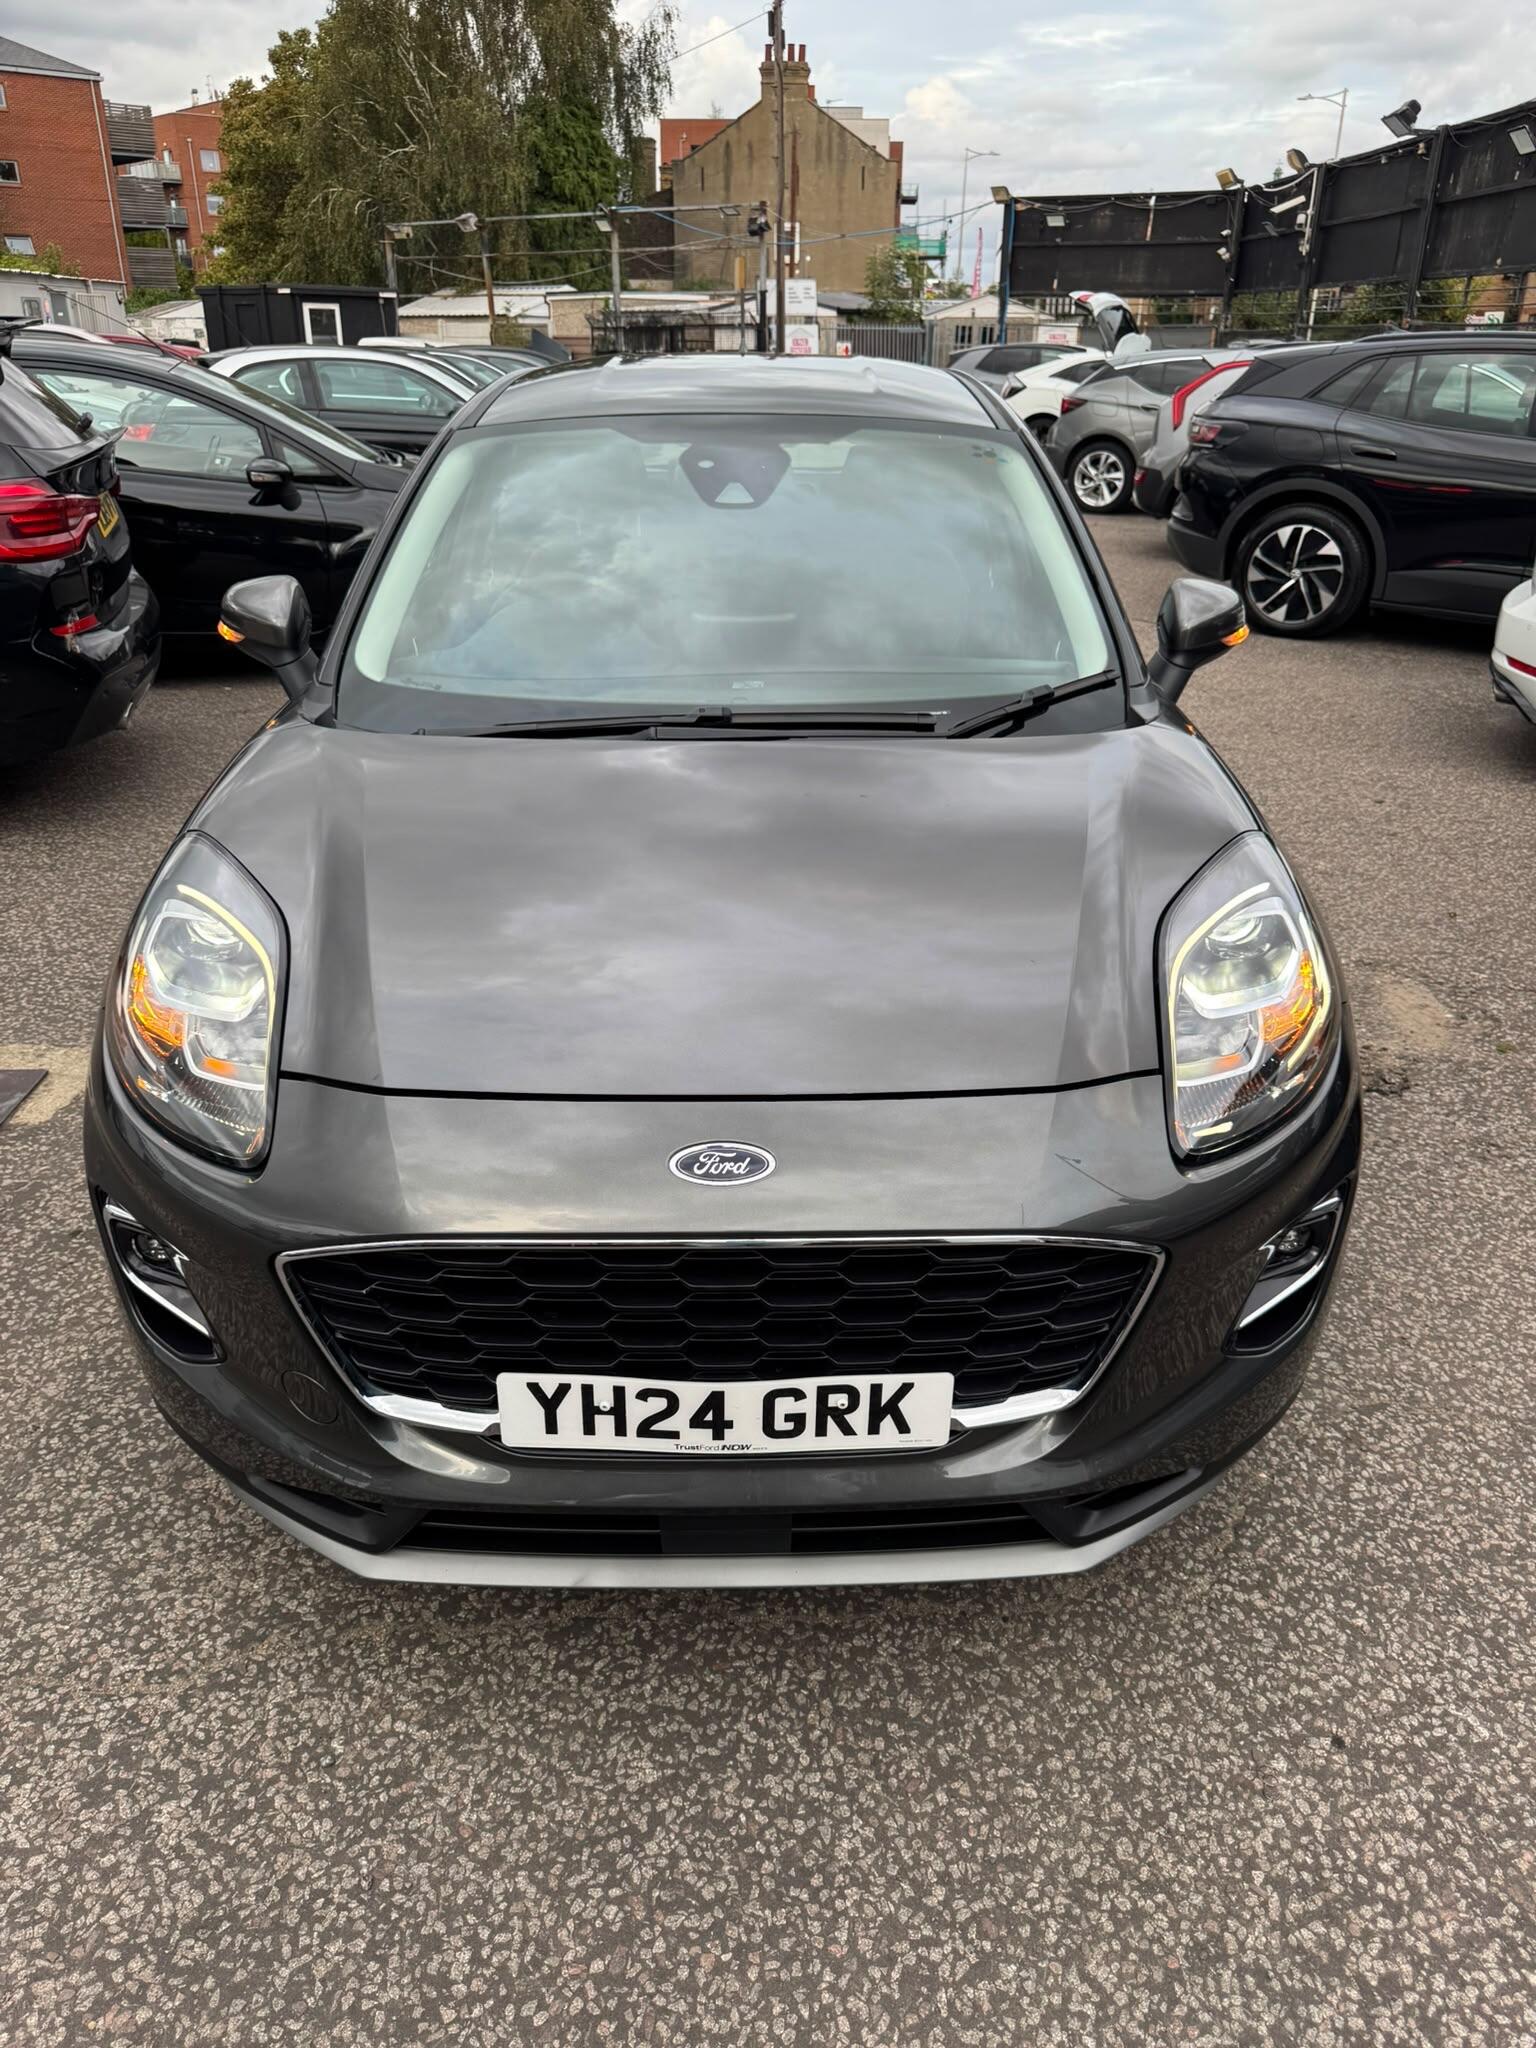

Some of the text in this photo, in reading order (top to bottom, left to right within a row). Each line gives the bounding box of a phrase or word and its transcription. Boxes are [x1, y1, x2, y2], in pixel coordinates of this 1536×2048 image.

[693, 1151, 751, 1175] Ford
[526, 1381, 916, 1441] YH24 GRK
[674, 1443, 720, 1452] TrustFord
[721, 1443, 752, 1452] NOW
